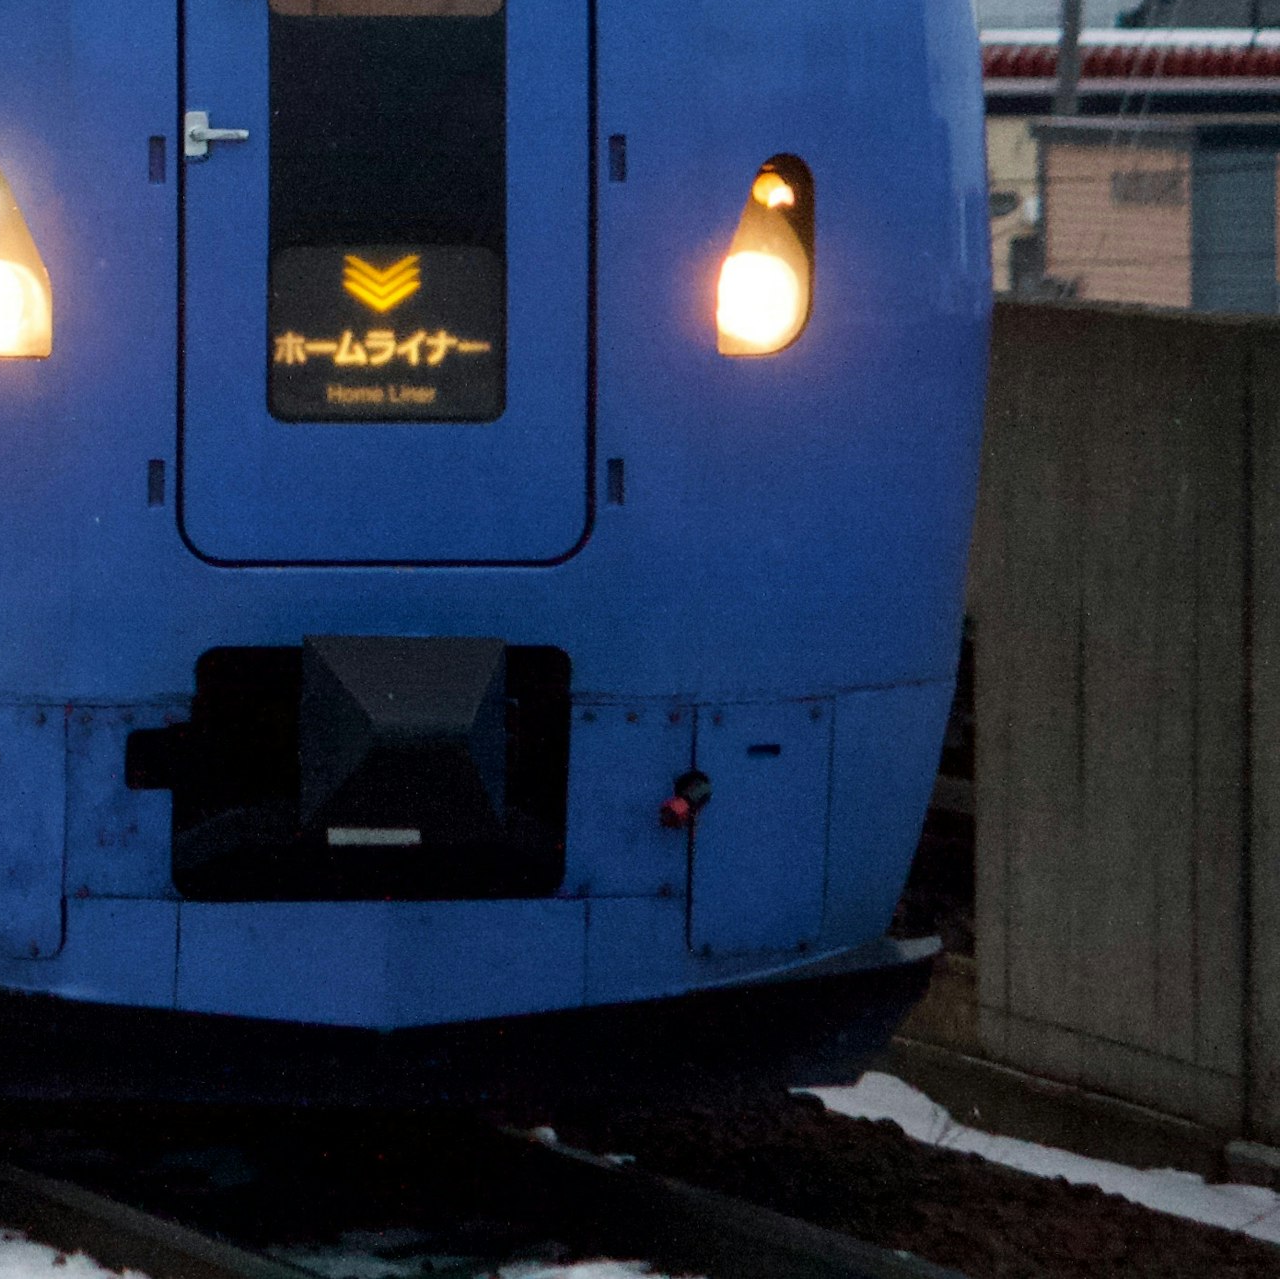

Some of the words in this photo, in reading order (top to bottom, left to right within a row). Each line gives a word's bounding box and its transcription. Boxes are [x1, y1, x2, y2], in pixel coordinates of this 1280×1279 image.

[274, 329, 491, 367] ホームライナー
